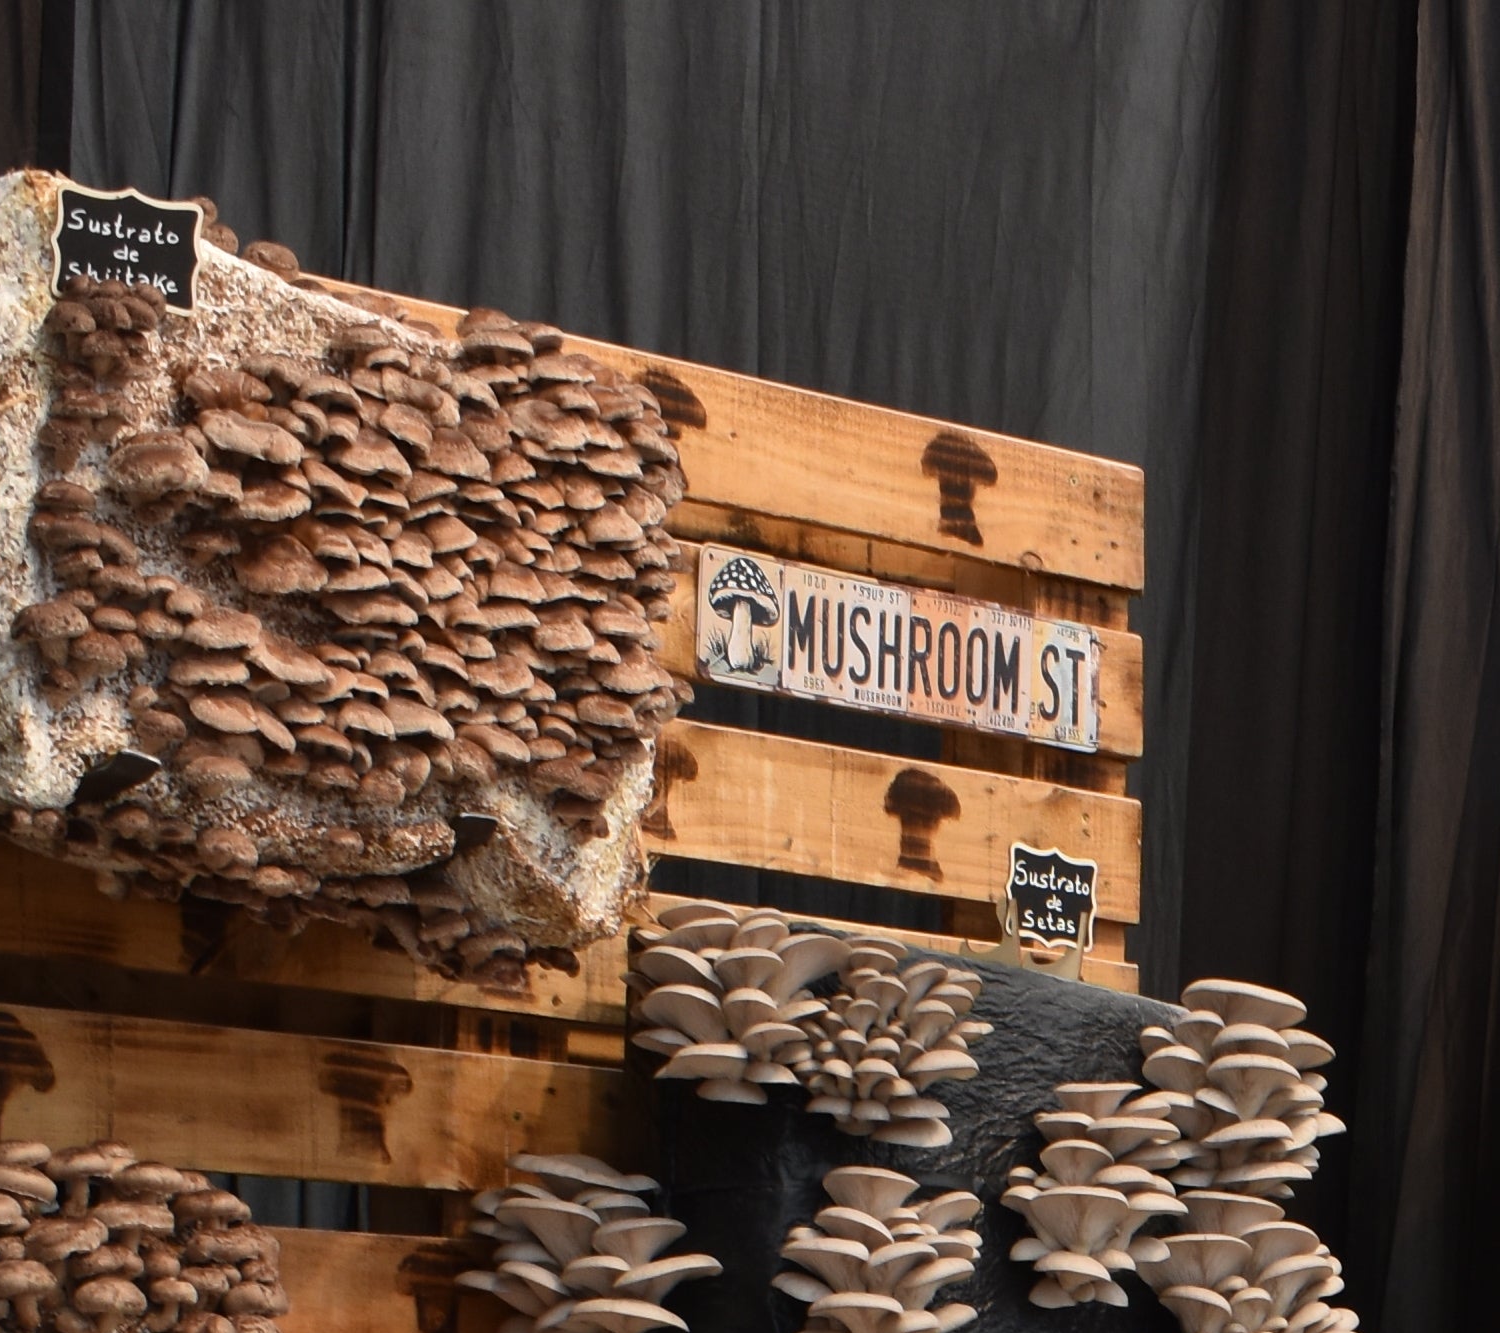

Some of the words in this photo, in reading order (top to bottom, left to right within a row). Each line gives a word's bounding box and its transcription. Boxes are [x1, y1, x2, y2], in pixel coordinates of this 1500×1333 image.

[66, 207, 180, 245] Sustrato
[112, 244, 140, 263] de
[788, 588, 1021, 715] MUSHROOM
[1038, 643, 1087, 727] ST
[1014, 859, 1090, 896] Sustrato
[1045, 893, 1063, 913] de
[1021, 908, 1076, 934] Setas
